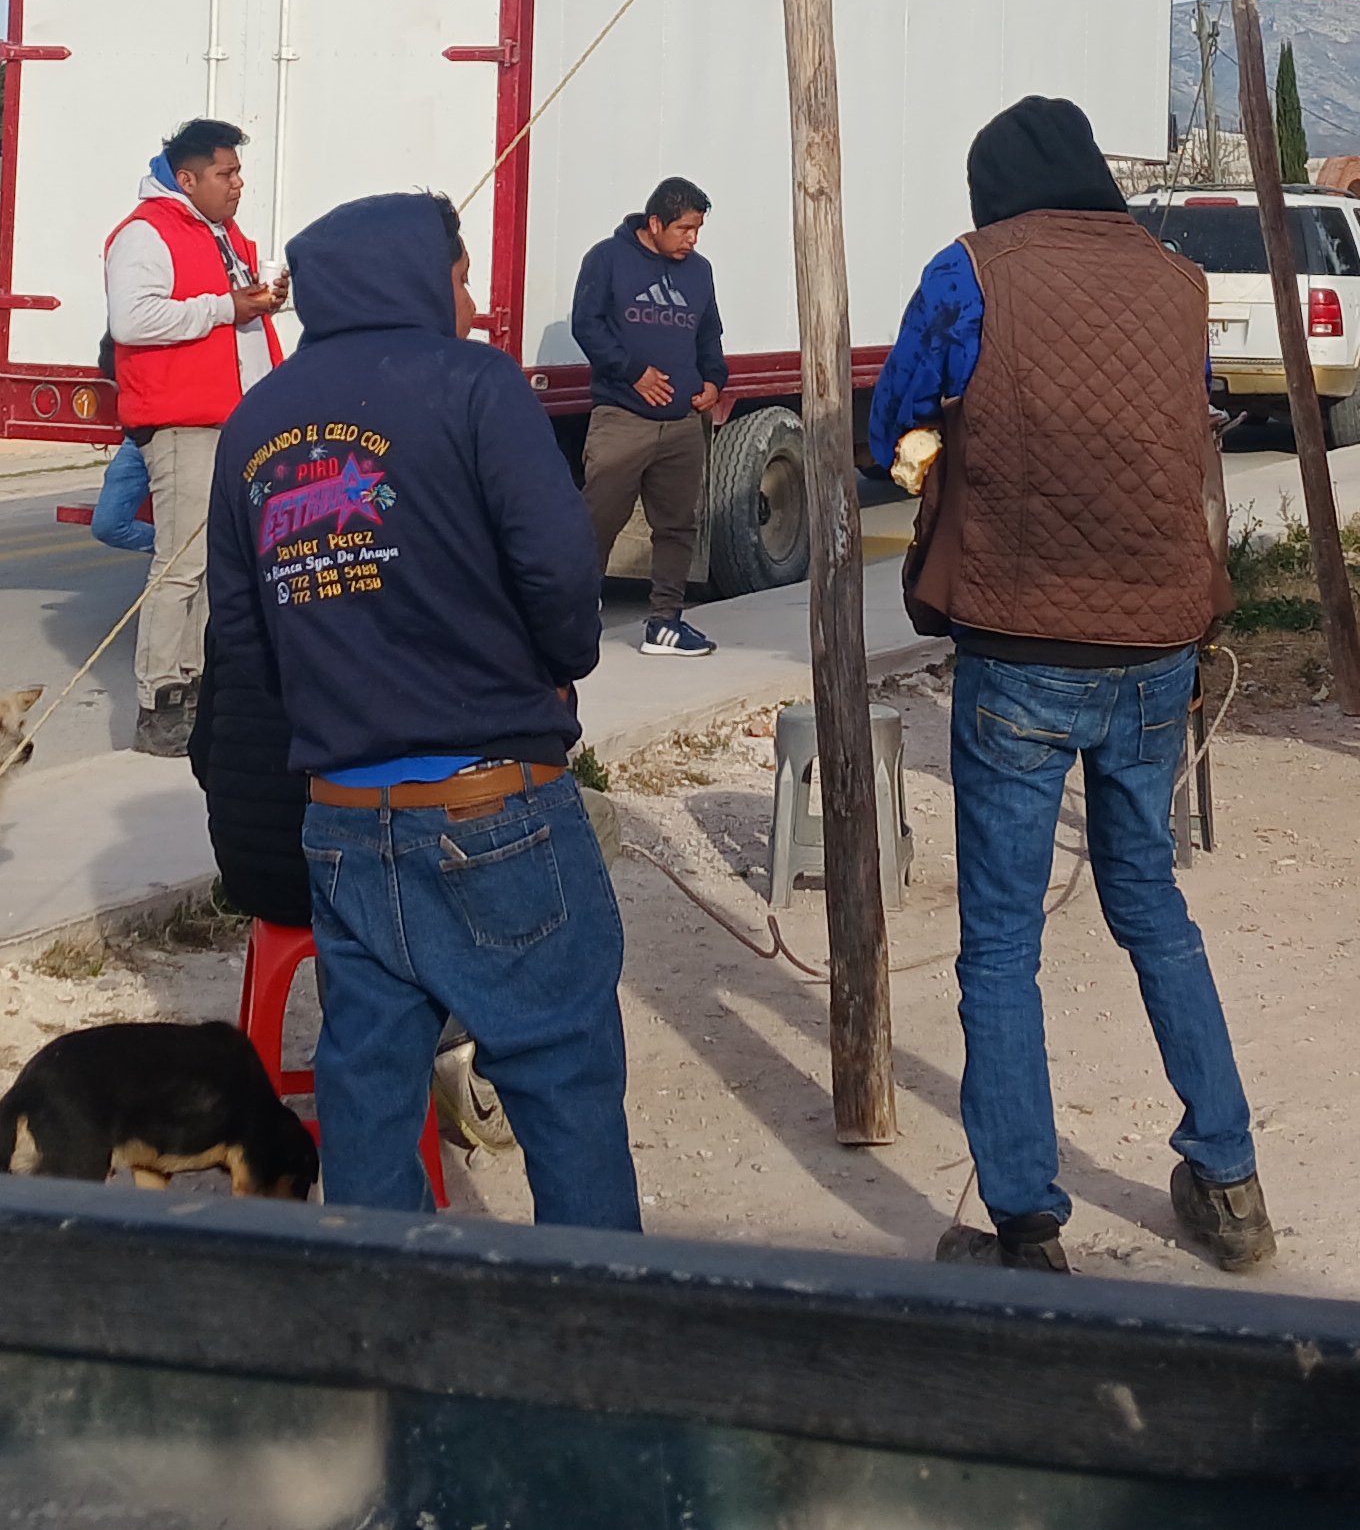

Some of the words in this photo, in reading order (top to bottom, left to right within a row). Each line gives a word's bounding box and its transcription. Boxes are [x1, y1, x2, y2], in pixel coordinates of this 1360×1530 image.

[624, 305, 696, 330] adidas
[306, 424, 318, 441] EL
[324, 423, 358, 441] CIELO
[360, 431, 390, 456] CON
[328, 531, 374, 549] Perez
[359, 546, 399, 561] Anaya
